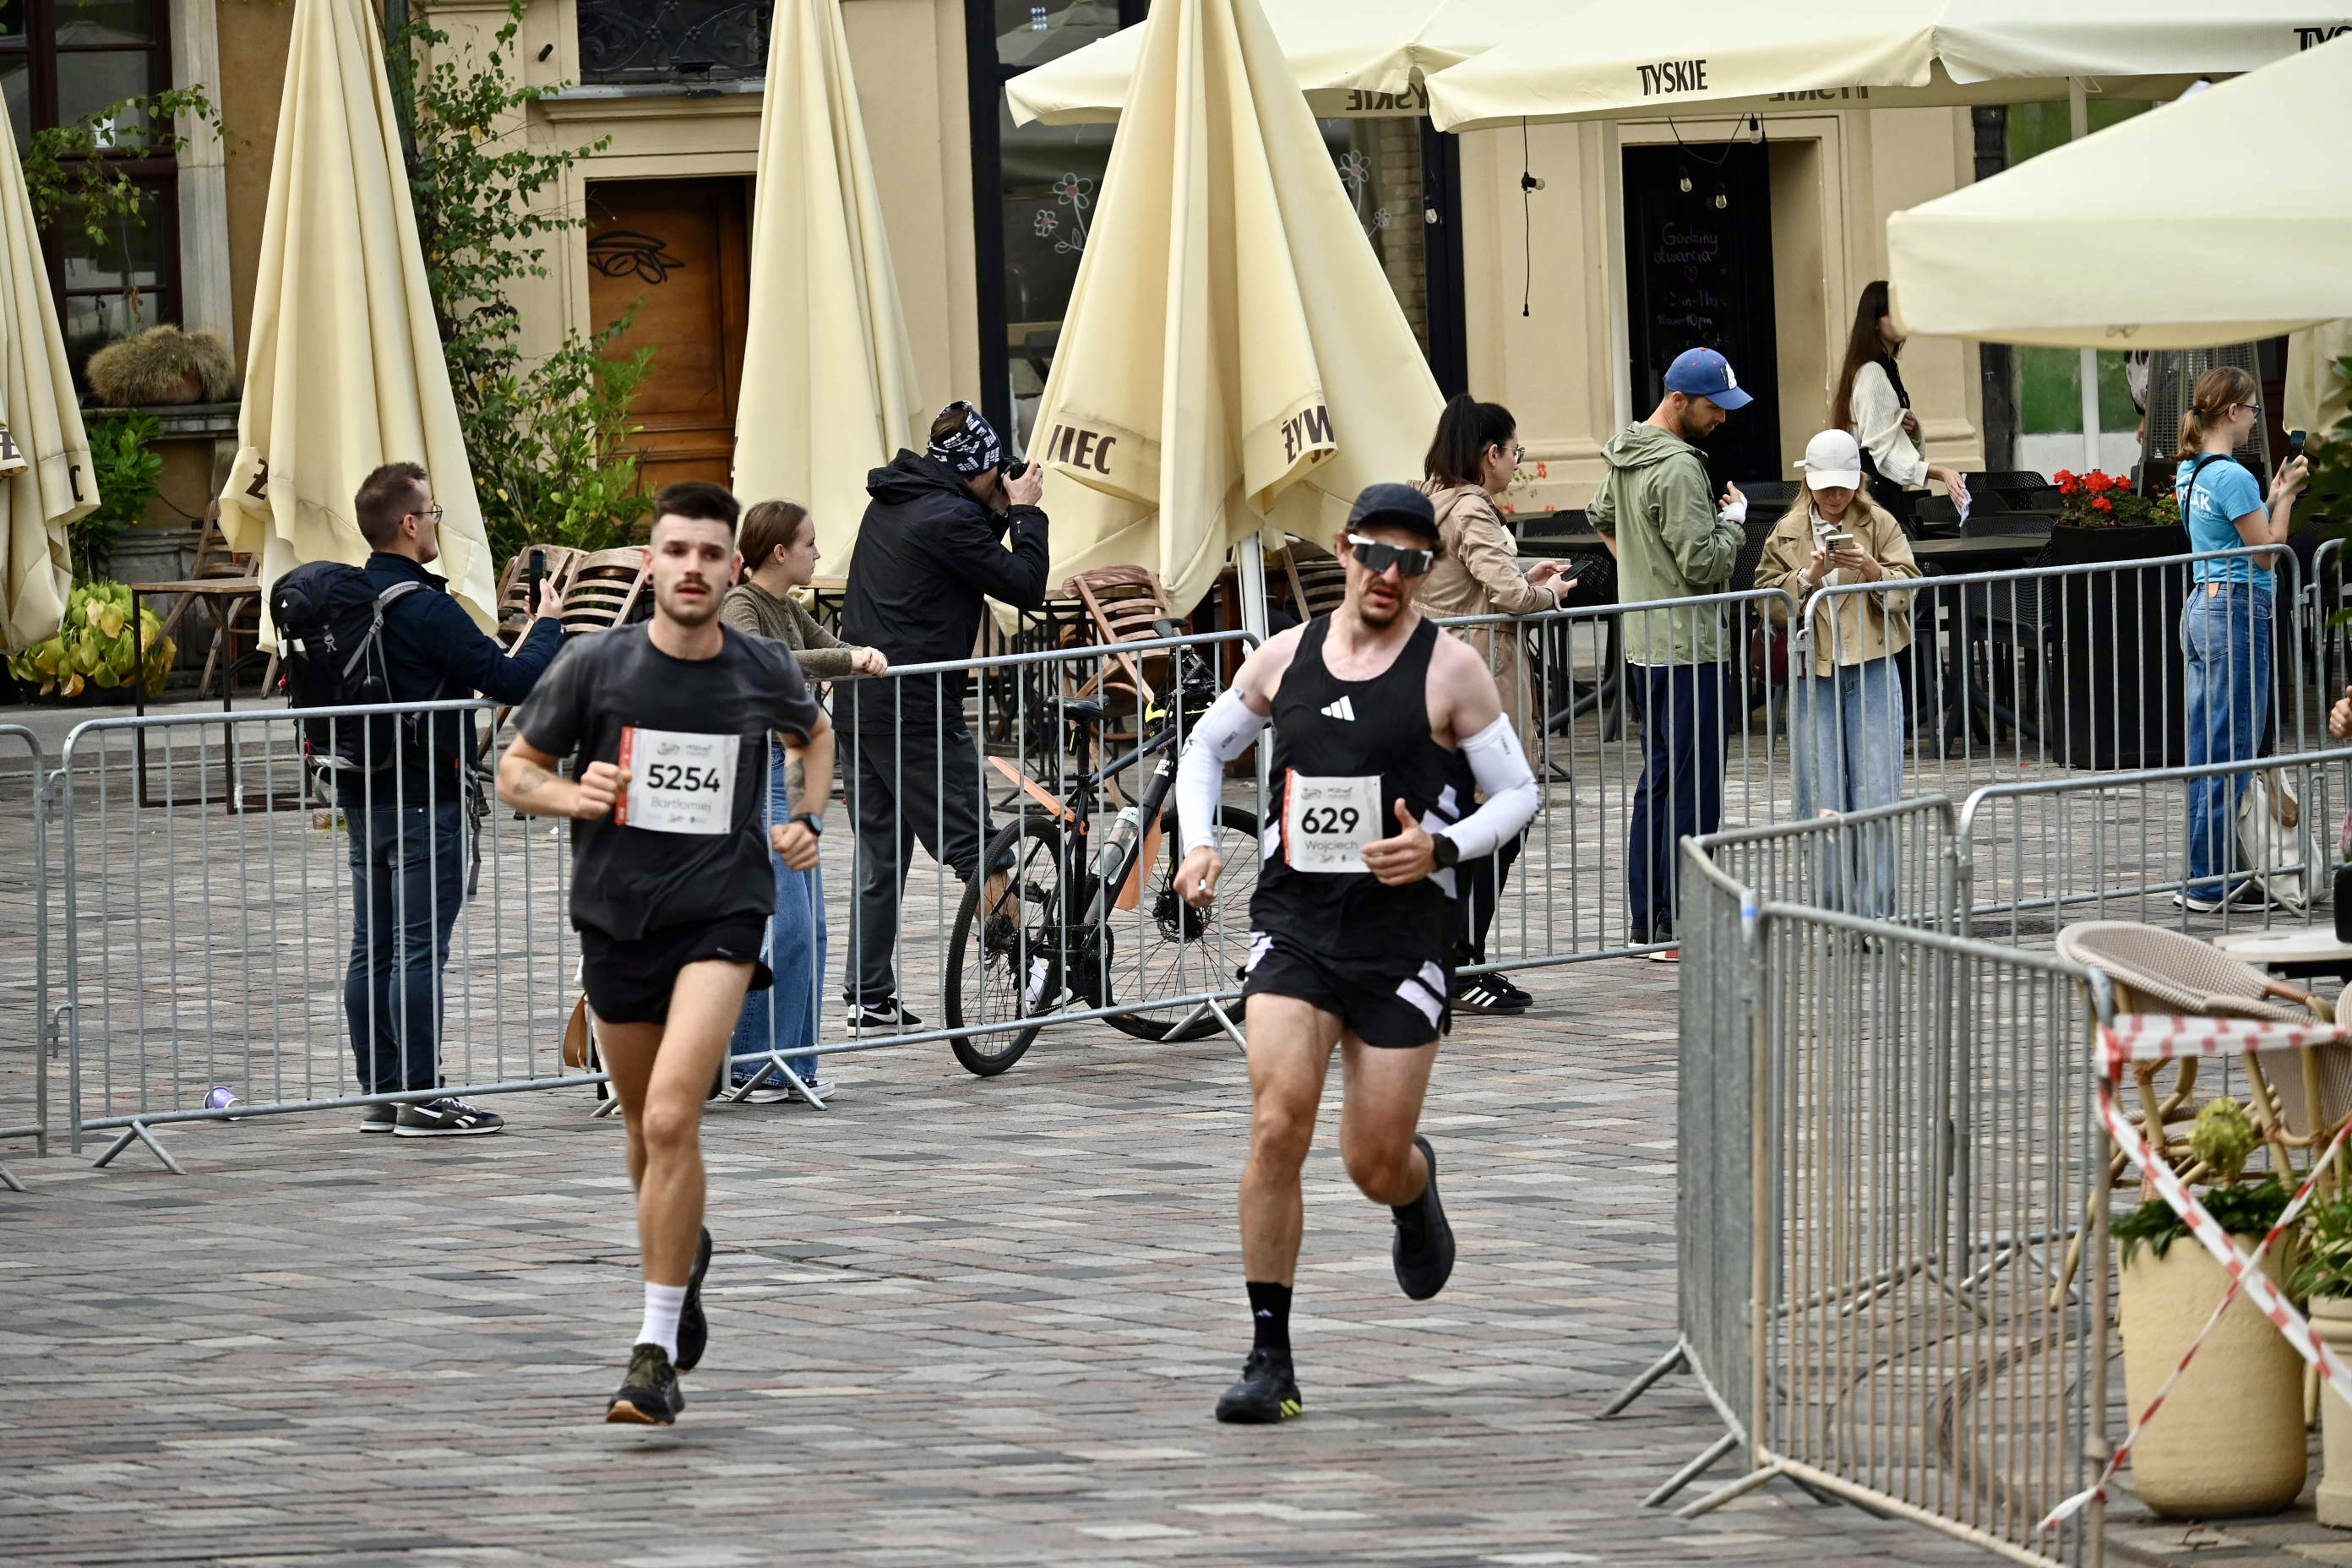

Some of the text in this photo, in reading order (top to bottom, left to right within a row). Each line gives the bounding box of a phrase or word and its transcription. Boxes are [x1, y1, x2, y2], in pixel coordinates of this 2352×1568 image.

[1636, 59, 1707, 96] TYSKIE
[1661, 221, 1718, 255] Godziny
[1653, 245, 1712, 264] otwarcia
[646, 763, 720, 792] 5254
[1301, 807, 1359, 835] 629
[1304, 840, 1359, 852] Wojciech
